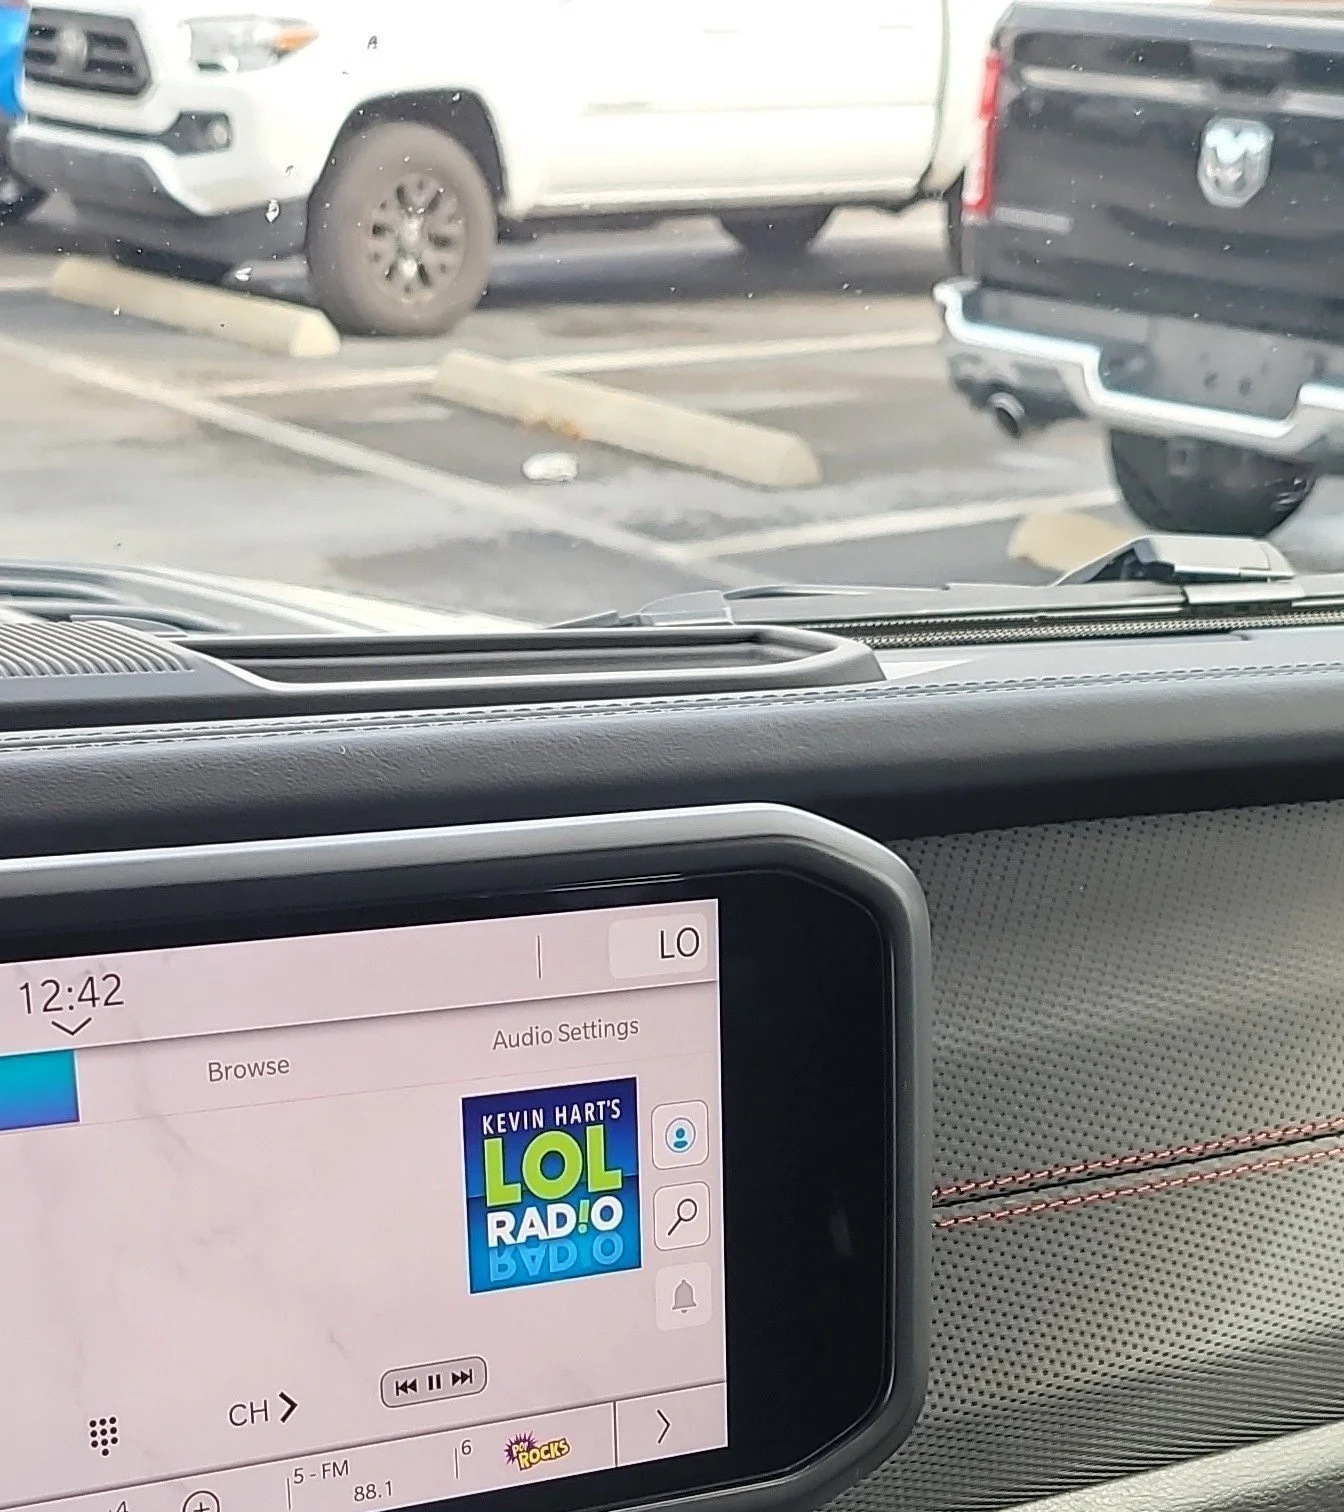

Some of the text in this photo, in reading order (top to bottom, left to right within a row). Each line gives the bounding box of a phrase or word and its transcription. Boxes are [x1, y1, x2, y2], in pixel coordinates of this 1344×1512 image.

[659, 927, 701, 960] LO
[19, 973, 126, 1016] 12:42
[492, 1016, 640, 1051] Audio Settings
[208, 1055, 290, 1083] Browse
[481, 1098, 623, 1136] KEVIN HART'S
[483, 1123, 624, 1209] LOL
[229, 1398, 270, 1428] CH
[461, 1438, 473, 1457] 6
[518, 1438, 570, 1469] ROCKS
[293, 1467, 306, 1485] 5
[320, 1459, 350, 1481] FM
[353, 1480, 394, 1503] 88.1
